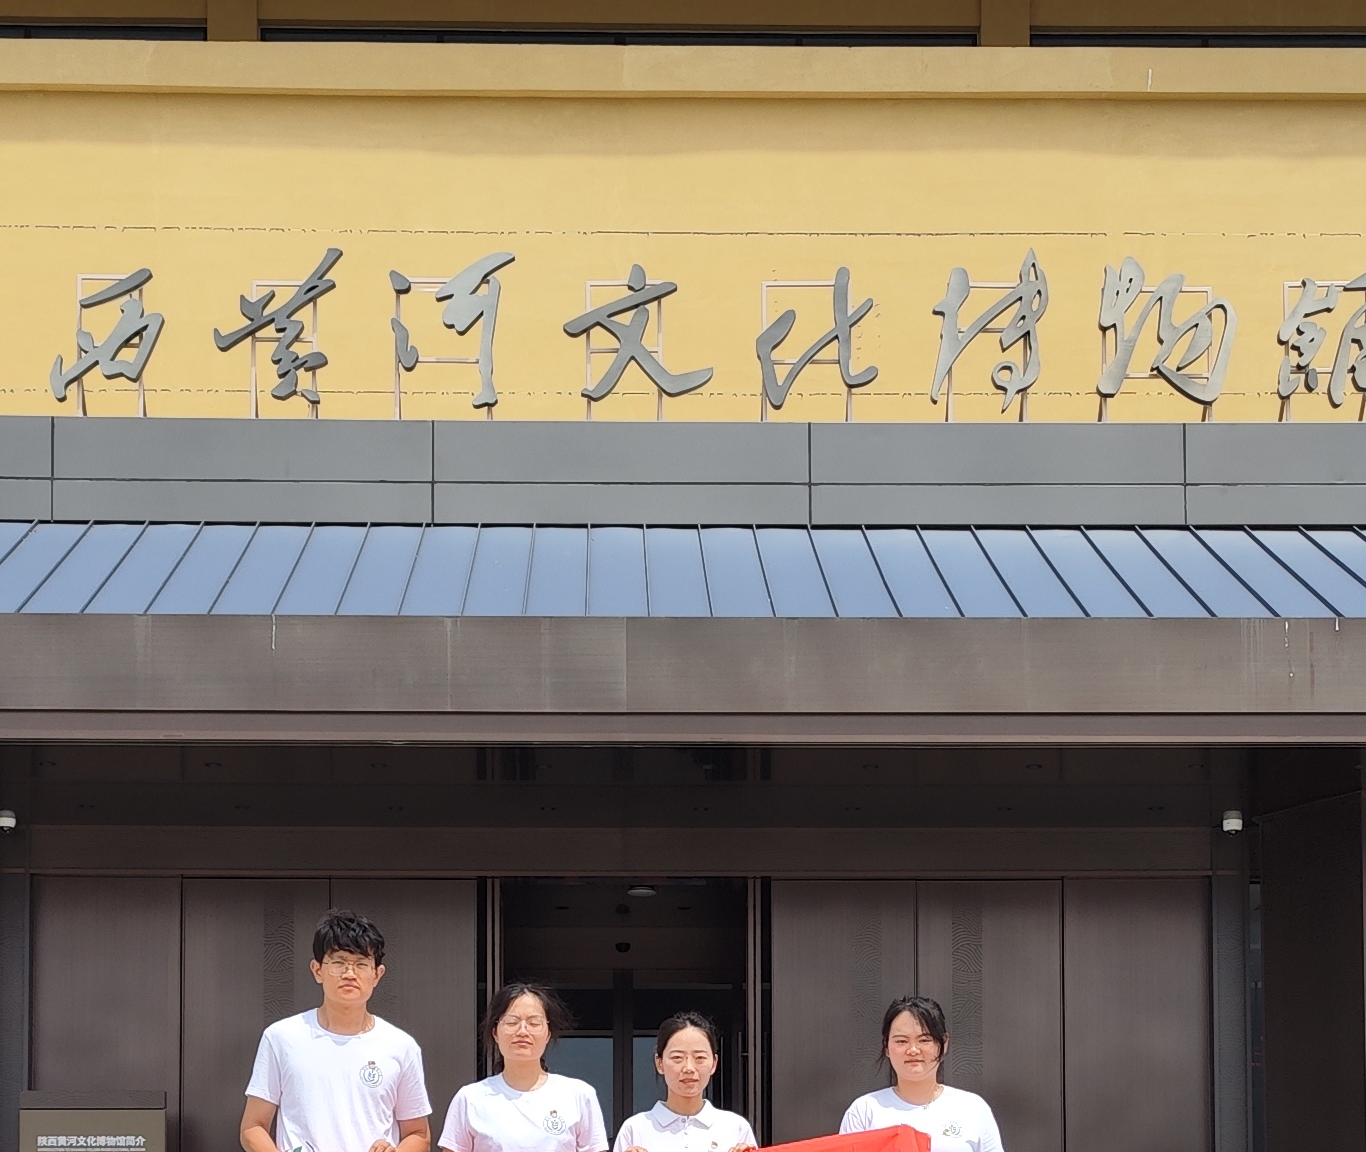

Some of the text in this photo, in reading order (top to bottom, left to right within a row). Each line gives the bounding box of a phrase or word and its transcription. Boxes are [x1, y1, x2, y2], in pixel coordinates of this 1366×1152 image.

[37, 1135, 146, 1147] 陕西黄河文化博物馆简介
